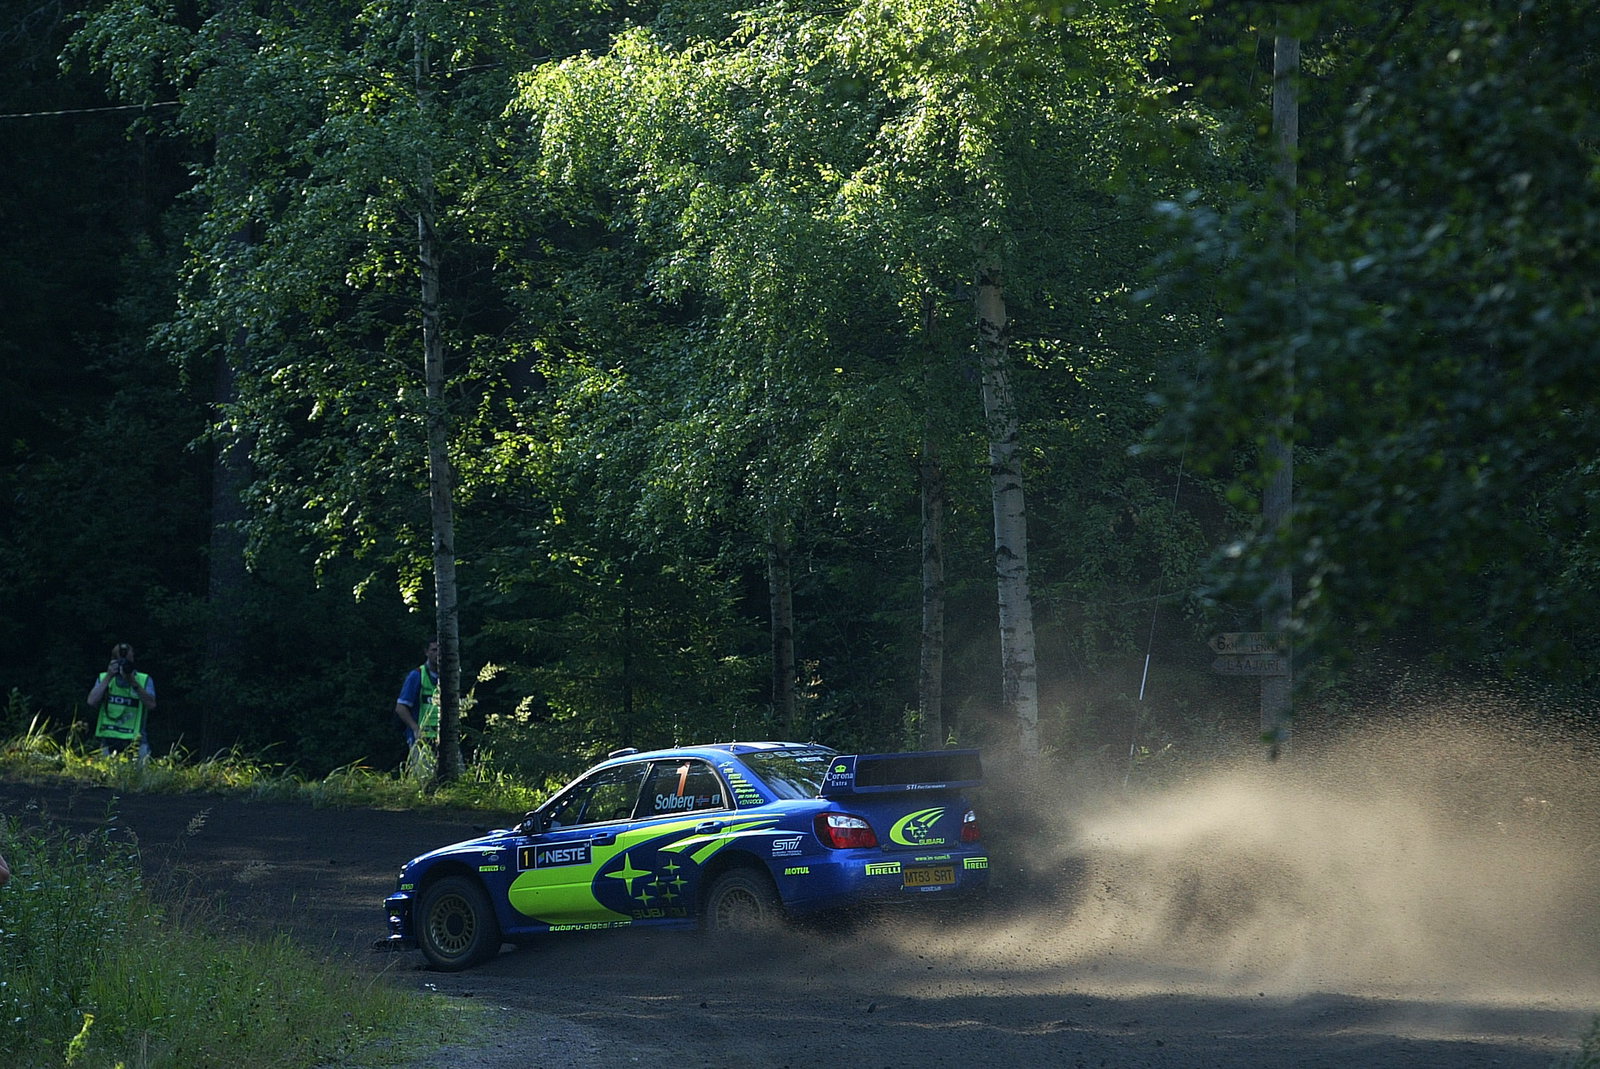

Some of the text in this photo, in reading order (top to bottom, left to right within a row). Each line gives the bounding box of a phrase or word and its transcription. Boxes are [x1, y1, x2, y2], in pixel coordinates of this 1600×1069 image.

[1217, 636, 1226, 651] 6
[676, 762, 691, 796] 1
[826, 772, 854, 782] Corona
[654, 793, 695, 811] Solberg
[523, 850, 529, 867] 1
[545, 848, 586, 864] NESTE
[963, 857, 988, 870] PIRELLI
[784, 867, 810, 875] MOTUL
[865, 861, 901, 876] PIRELLI
[905, 869, 953, 884] MT53 SRT
